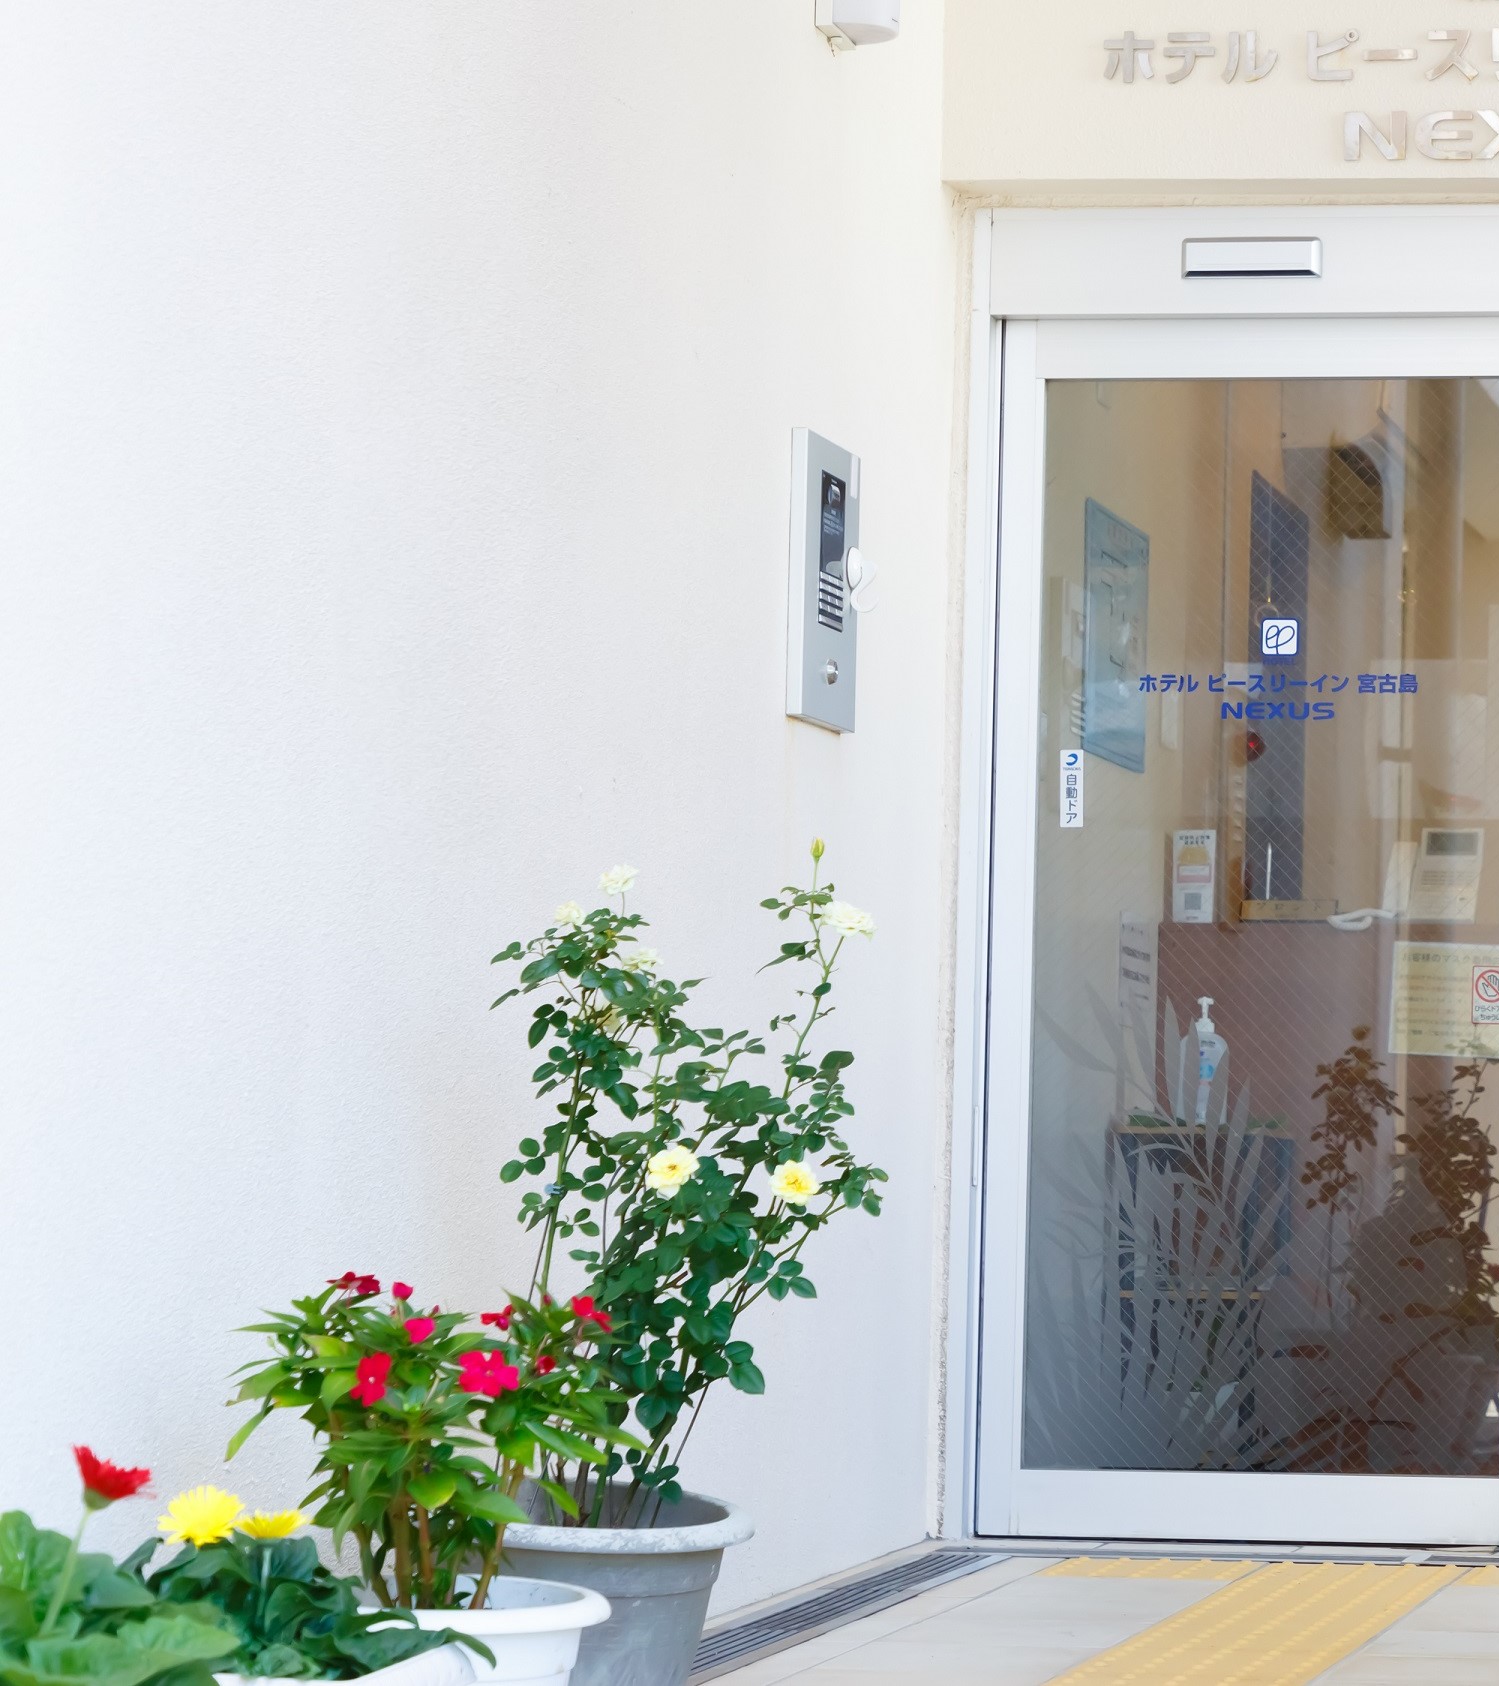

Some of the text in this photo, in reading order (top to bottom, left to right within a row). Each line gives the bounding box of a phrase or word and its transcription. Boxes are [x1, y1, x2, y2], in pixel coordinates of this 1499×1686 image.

[1102, 29, 1279, 84] ホテル
[1138, 674, 1418, 694] ホテル ピースリーイン 宮古島
[1220, 702, 1335, 720] NEXUS
[1065, 774, 1078, 824] 自動ドア
